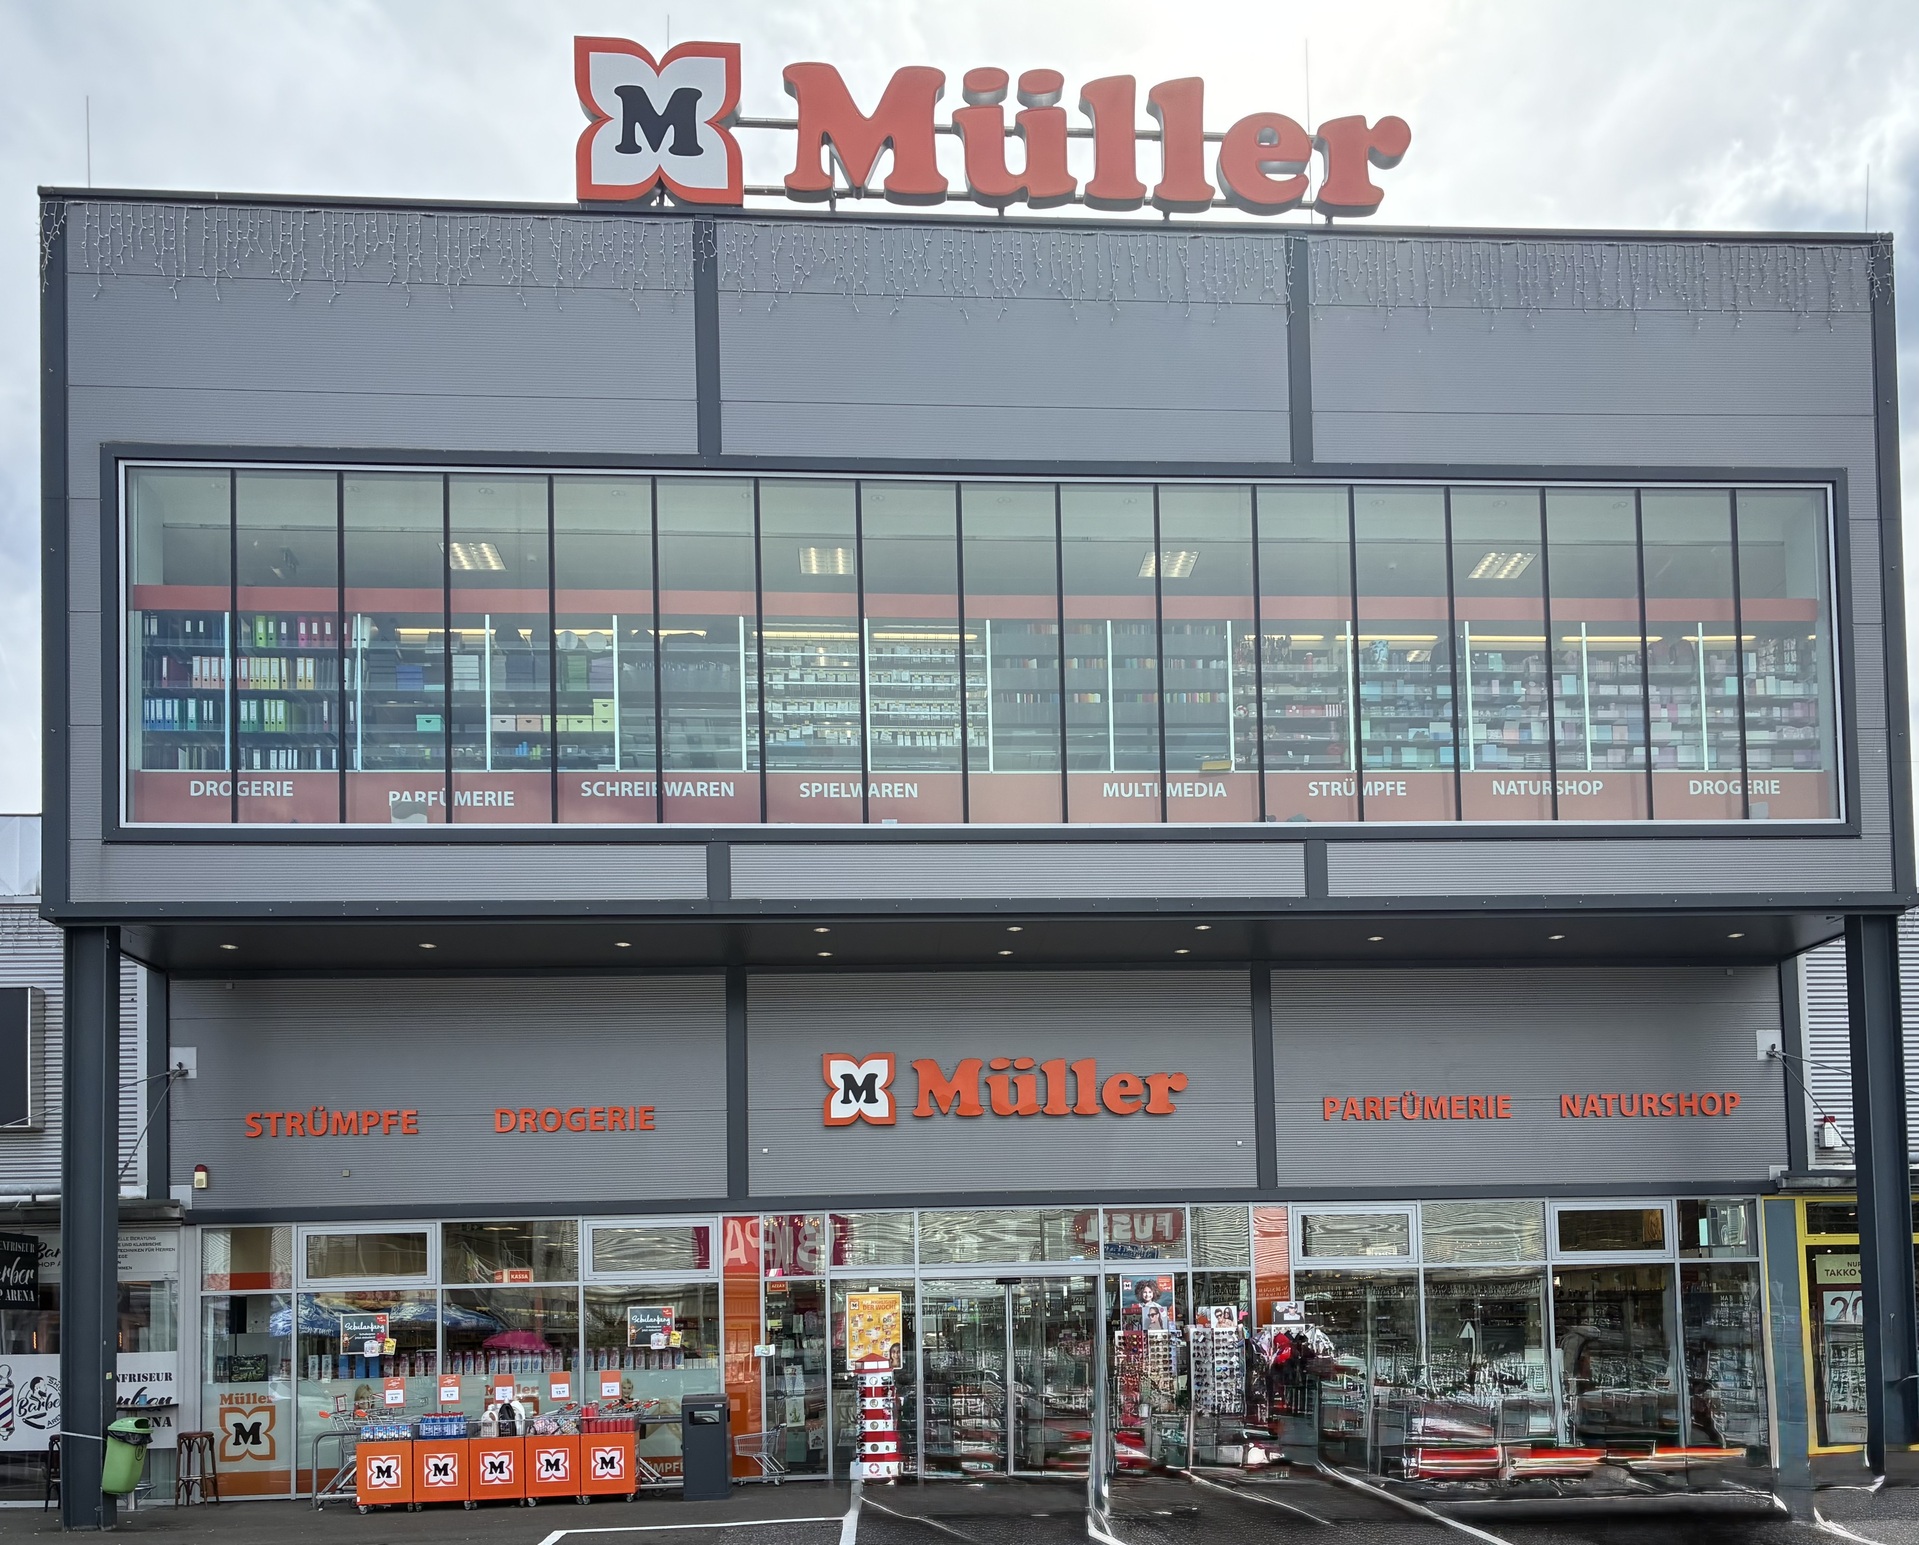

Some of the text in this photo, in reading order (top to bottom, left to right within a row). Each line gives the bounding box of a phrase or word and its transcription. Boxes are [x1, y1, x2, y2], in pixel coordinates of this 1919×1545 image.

[615, 62, 1412, 216] M Müller
[190, 780, 294, 797] DROGERIE
[799, 782, 918, 798] SPIELWAREN
[1308, 778, 1407, 797] STRÜMPFE
[1492, 780, 1604, 796] NATURSHOP
[840, 1057, 1189, 1118] M Müller
[1323, 1090, 1513, 1121] PARFÜMERIE
[1560, 1091, 1741, 1118] NATURSHOP
[244, 1105, 419, 1138] STRÜMPFE
[494, 1105, 656, 1133] DROGERIE
[1825, 1268, 1857, 1277] TAKKO
[5, 1289, 35, 1302] ARENA
[485, 1384, 539, 1396] Mler
[219, 1392, 276, 1406] Müller
[232, 1421, 262, 1446] M
[433, 1463, 449, 1477] M
[489, 1461, 505, 1475] M
[545, 1458, 561, 1472] M
[600, 1456, 616, 1470] M
[375, 1464, 392, 1479] M
